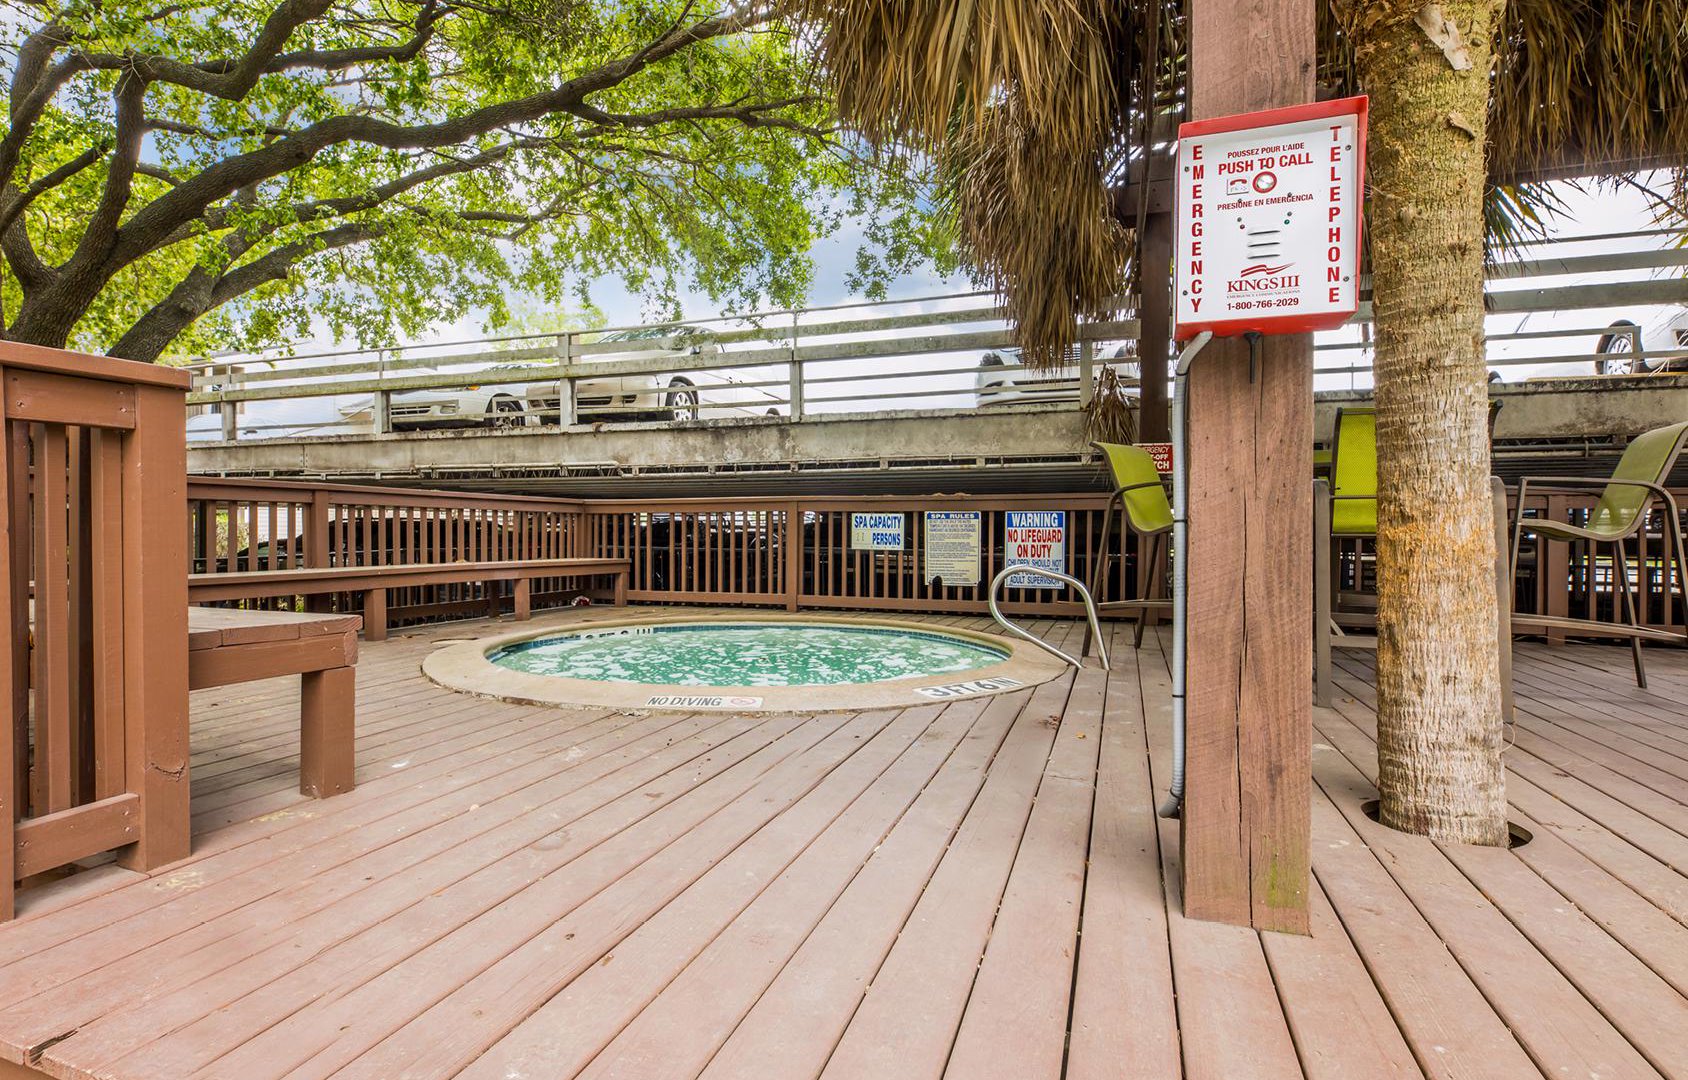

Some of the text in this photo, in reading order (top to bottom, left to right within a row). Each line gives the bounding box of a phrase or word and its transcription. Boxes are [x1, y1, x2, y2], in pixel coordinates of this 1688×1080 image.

[1227, 142, 1305, 159] POUSSEZ POUR L'AIDE
[1218, 152, 1314, 175] PUSH TO CALL
[1217, 193, 1314, 211] PRESIONE EN EMERGENCIA
[1327, 125, 1342, 303] TELEPHONE
[1190, 145, 1204, 313] EMERGENCY
[1227, 274, 1300, 293] KINGS III
[1226, 297, 1300, 311] 1-800-766-2029
[854, 515, 902, 529] SPA CAPACITY
[1012, 512, 1059, 527] WARNING
[872, 532, 901, 546] PERSONS
[1007, 529, 1062, 543] NO LIFEGUARD
[1017, 544, 1052, 558] ON DUTY
[1031, 558, 1051, 567] SHOULD
[1052, 559, 1062, 567] NOT
[1010, 576, 1025, 584] ADULT
[974, 681, 1000, 690] 6
[647, 696, 722, 706] NO DIVING
